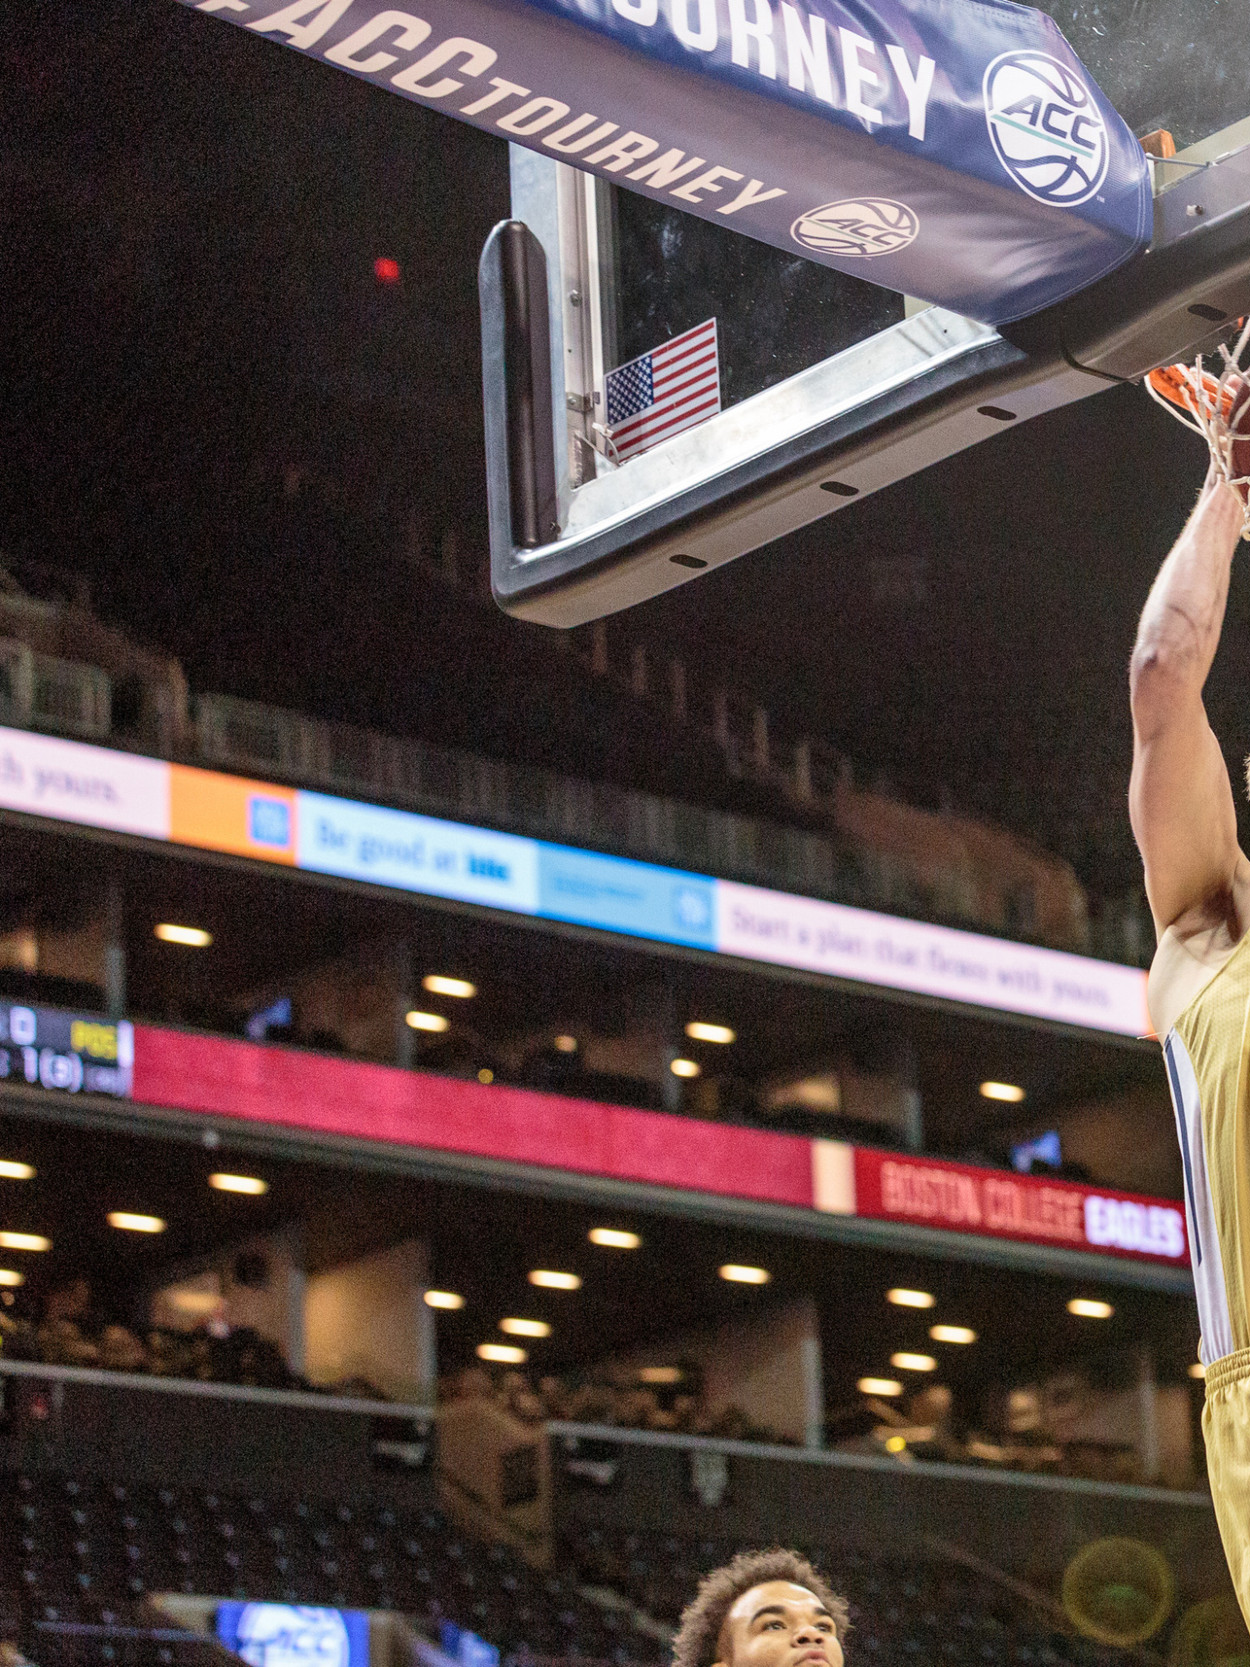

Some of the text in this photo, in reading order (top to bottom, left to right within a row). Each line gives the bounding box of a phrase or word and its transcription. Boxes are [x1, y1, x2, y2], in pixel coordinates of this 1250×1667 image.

[193, 0, 788, 215] ACCTOURNEY
[1001, 94, 1102, 151] ACC
[815, 218, 913, 247] ACC
[880, 1158, 1185, 1259] BOSTON COLLEGE EAGLES
